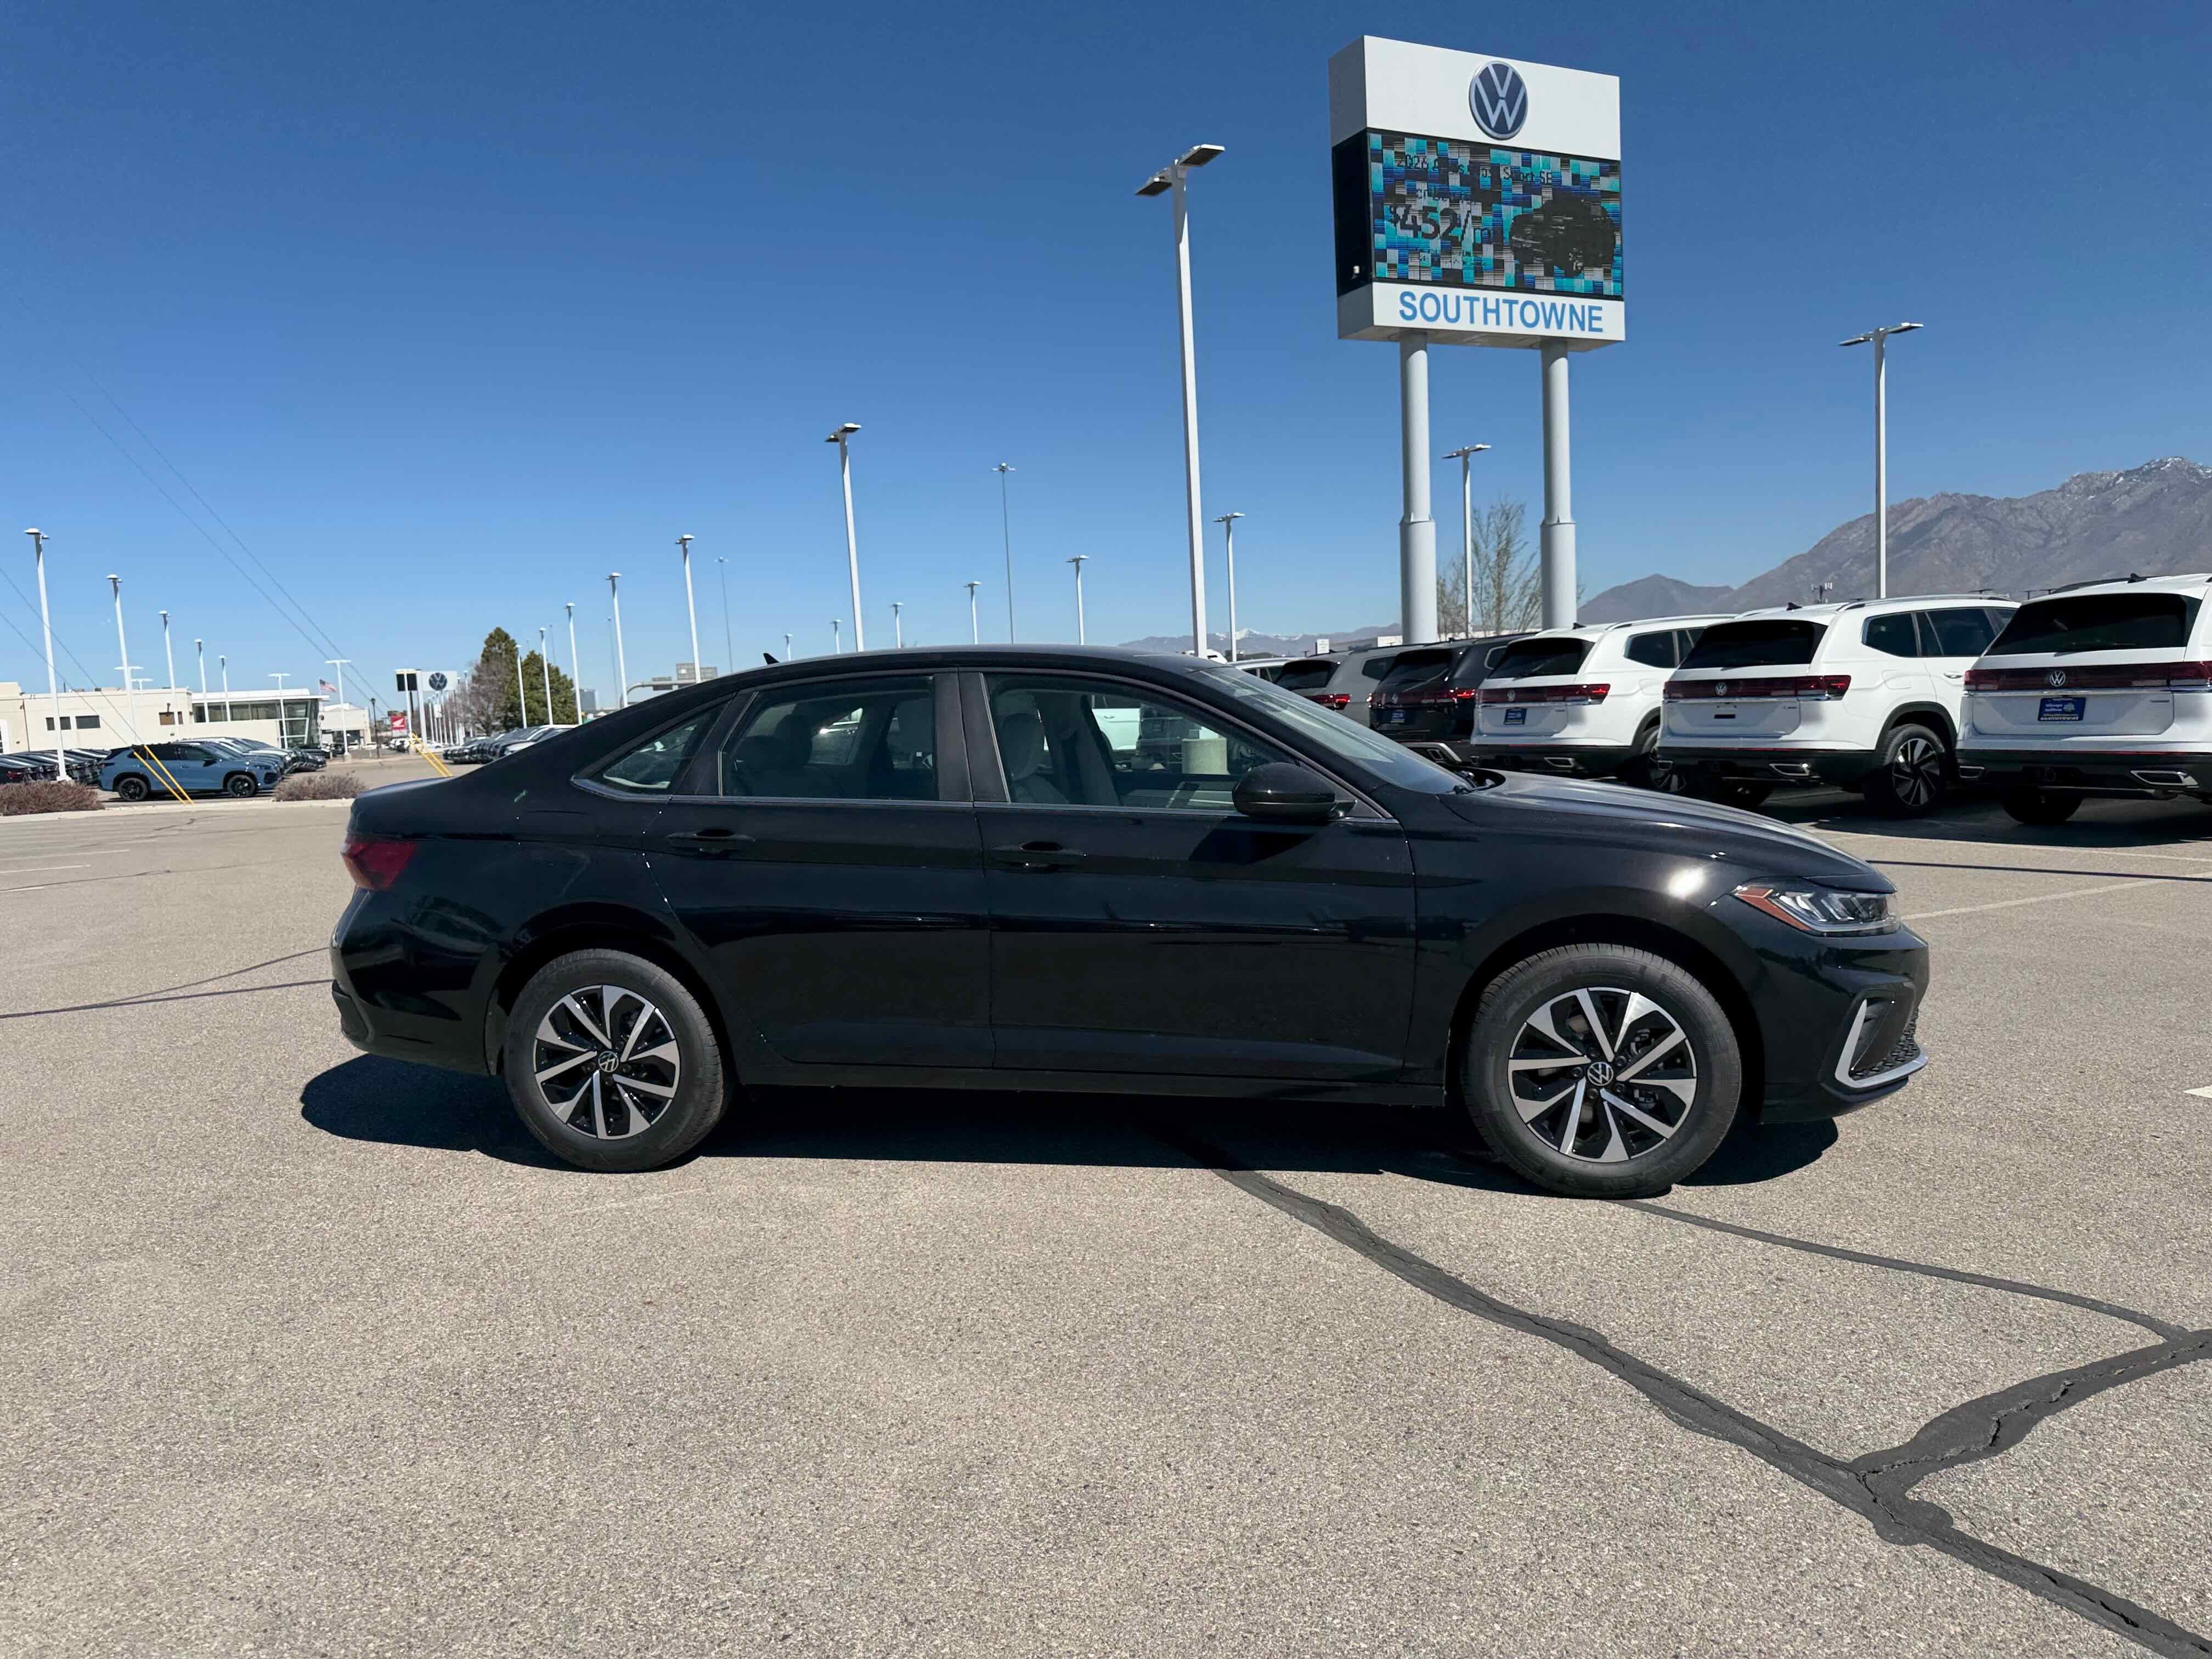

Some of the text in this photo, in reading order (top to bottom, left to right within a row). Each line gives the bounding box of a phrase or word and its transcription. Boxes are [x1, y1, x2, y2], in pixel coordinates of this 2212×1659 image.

[1470, 61, 1527, 136] VW
[1399, 290, 1603, 333] SOUTHTOWNE
[2050, 671, 2066, 686] VW
